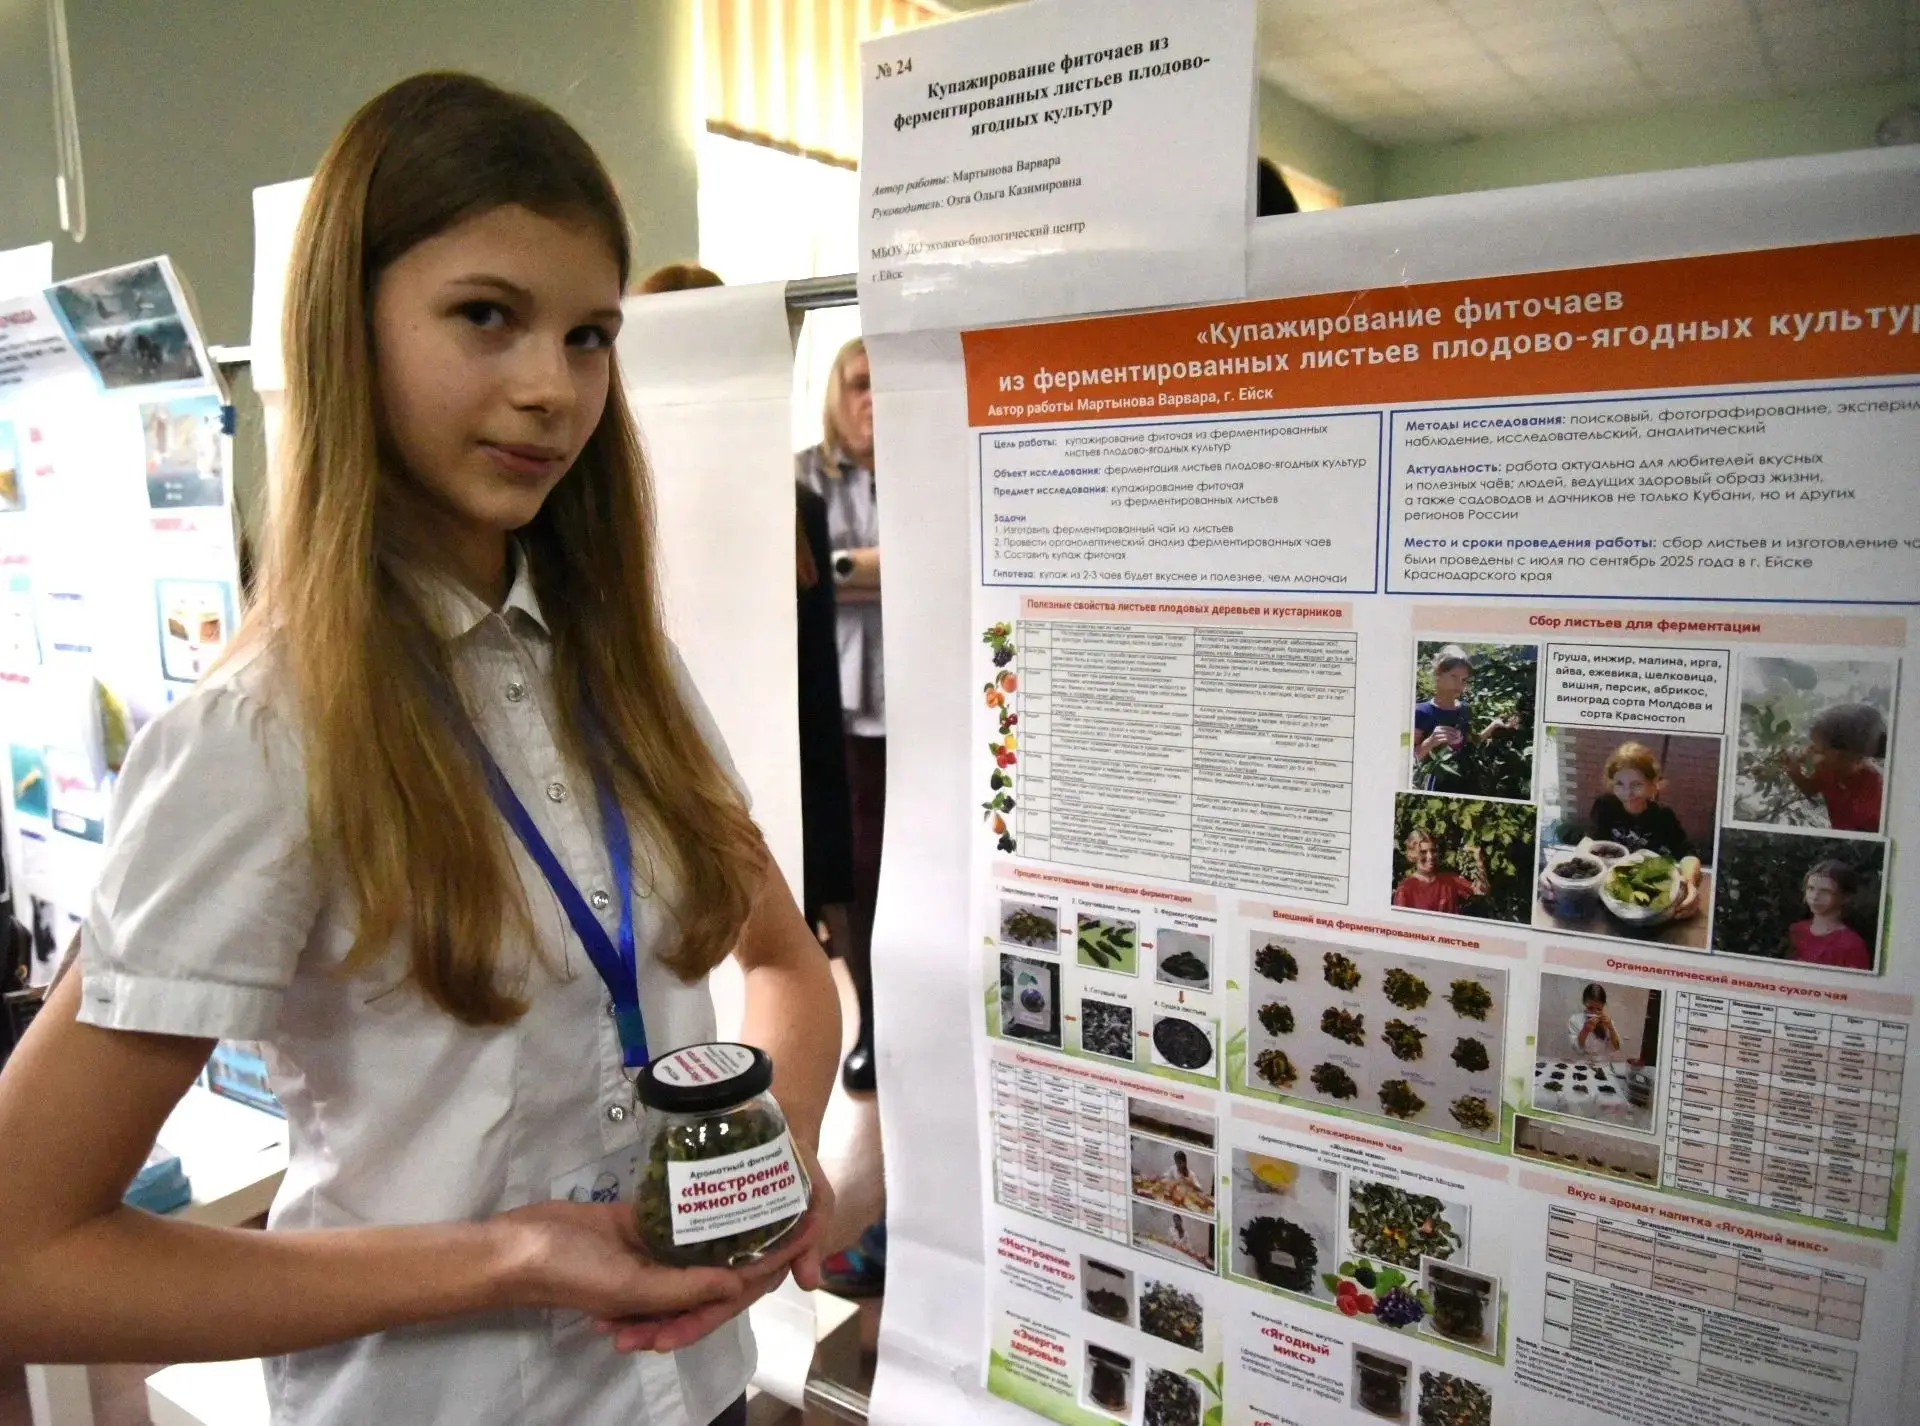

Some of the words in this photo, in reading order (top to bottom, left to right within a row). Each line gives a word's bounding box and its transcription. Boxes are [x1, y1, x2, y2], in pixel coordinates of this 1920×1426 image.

[876, 63, 892, 80] №
[897, 58, 912, 75] 24
[928, 62, 1055, 98] Купажирование
[1060, 43, 1143, 74] фиточаев
[1150, 37, 1169, 52] из
[894, 88, 1048, 131] ферментированных
[1053, 73, 1123, 96] листьев
[1129, 57, 1210, 81] плодово-
[971, 114, 1038, 136] ягодных
[1044, 99, 1113, 124] культур
[872, 184, 904, 196] Автор
[953, 165, 1013, 183] Мартынова
[1016, 157, 1061, 172] Варвара
[1197, 308, 1441, 348] «Купажирование
[1455, 292, 1624, 328] фиточаев
[999, 375, 1025, 392] из
[1033, 355, 1289, 392] ферментированных
[1300, 344, 1420, 369] листьев
[1432, 318, 1753, 360] плодово-ягодных
[988, 405, 1024, 417] Автор
[1027, 400, 1074, 417] работы
[1077, 397, 1155, 412] Мартынова
[1158, 393, 1220, 407] Варвара,
[1224, 391, 1234, 401] г.
[1239, 387, 1273, 401] Ейск
[1406, 421, 1459, 431] Методы
[1646, 421, 1766, 438] аналитический
[994, 440, 1016, 449] Цель
[1065, 435, 1145, 447] купажирование
[1147, 432, 1193, 443] фиточая
[1195, 431, 1207, 439] из
[1209, 426, 1328, 440] ферментированных
[1065, 449, 1101, 458] листьев
[1103, 445, 1189, 456] плодово-ягодных
[1191, 443, 1231, 454] культур
[993, 469, 1028, 479] Объект
[1104, 465, 1179, 476] ферментация
[1181, 463, 1222, 472] листьев
[1225, 461, 1319, 471] плодово-ягодных
[1322, 458, 1367, 469] культур
[1406, 464, 1502, 476] Актуальность:
[1506, 460, 1558, 474] работа
[1561, 460, 1635, 472] актуальна
[1639, 459, 1664, 469] для
[1667, 453, 1754, 467] любителей
[1759, 454, 1823, 467] вкусных
[994, 487, 1035, 497] Предмет
[1111, 484, 1194, 494] купажирование
[1196, 481, 1244, 493] фиточая
[1111, 499, 1122, 507] из
[1124, 497, 1233, 508] ферментированных
[1236, 496, 1279, 504] листьев
[1404, 512, 1465, 522] регионов
[1468, 509, 1519, 520] России
[1404, 538, 1447, 548] Место
[1451, 540, 1458, 548] и
[1462, 539, 1503, 550] сроки
[1507, 539, 1591, 549] проведения
[1595, 537, 1657, 550] работы:
[1662, 536, 1703, 550] сбор
[1707, 538, 1767, 549] листьев
[1772, 539, 1782, 548] и
[1786, 539, 1899, 549] изготовление
[1404, 554, 1436, 565] были
[1440, 556, 1514, 567] проведены
[1517, 557, 1526, 566] с
[1530, 557, 1564, 566] июля
[1568, 557, 1586, 566] по
[1589, 555, 1656, 568] сентябрь
[1660, 555, 1694, 567] 2025
[1698, 558, 1734, 568] года
[1738, 558, 1746, 568] в
[1750, 558, 1760, 568] г.
[1765, 556, 1813, 568] Ейске
[1404, 569, 1517, 582] Краснодарского
[1520, 572, 1552, 583] края
[1027, 599, 1072, 610] Полезные
[1073, 601, 1116, 611] свойства
[1118, 603, 1156, 612] листьев
[1158, 604, 1209, 615] плодовых
[1211, 606, 1261, 616] деревьев
[1263, 607, 1270, 616] и
[1272, 608, 1342, 618] кустарников
[1529, 615, 1561, 629] Сбор
[1564, 619, 1622, 629] листьев
[1625, 620, 1653, 631] для
[1657, 620, 1761, 634] ферментации
[1557, 695, 1610, 706] виноград
[1612, 698, 1646, 707] сорта
[1649, 698, 1702, 710] Молдова
[1580, 710, 1613, 720] сорта
[1615, 711, 1686, 723] Красностоп
[1272, 910, 1314, 924] Внешний
[1316, 918, 1334, 929] вид
[1336, 920, 1436, 942] ферментированных
[1437, 937, 1480, 949] листьев
[1606, 959, 1728, 984] Органолептический
[1731, 979, 1776, 991] анализ
[1778, 986, 1822, 998] сухого
[1824, 992, 1848, 1001] чая
[681, 1161, 789, 1197] «Настроение
[690, 1161, 745, 1180] Ароматный
[677, 1192, 748, 1214] южного
[752, 1174, 795, 1198] лета»
[1567, 1186, 1596, 1201] Вкус
[1599, 1195, 1607, 1203] и
[1609, 1198, 1656, 1214] аромат
[1658, 1209, 1713, 1228] напитка
[1715, 1222, 1783, 1243] «Ягодный
[1786, 1238, 1829, 1252] микс»
[1261, 1328, 1330, 1356] «Ягодный
